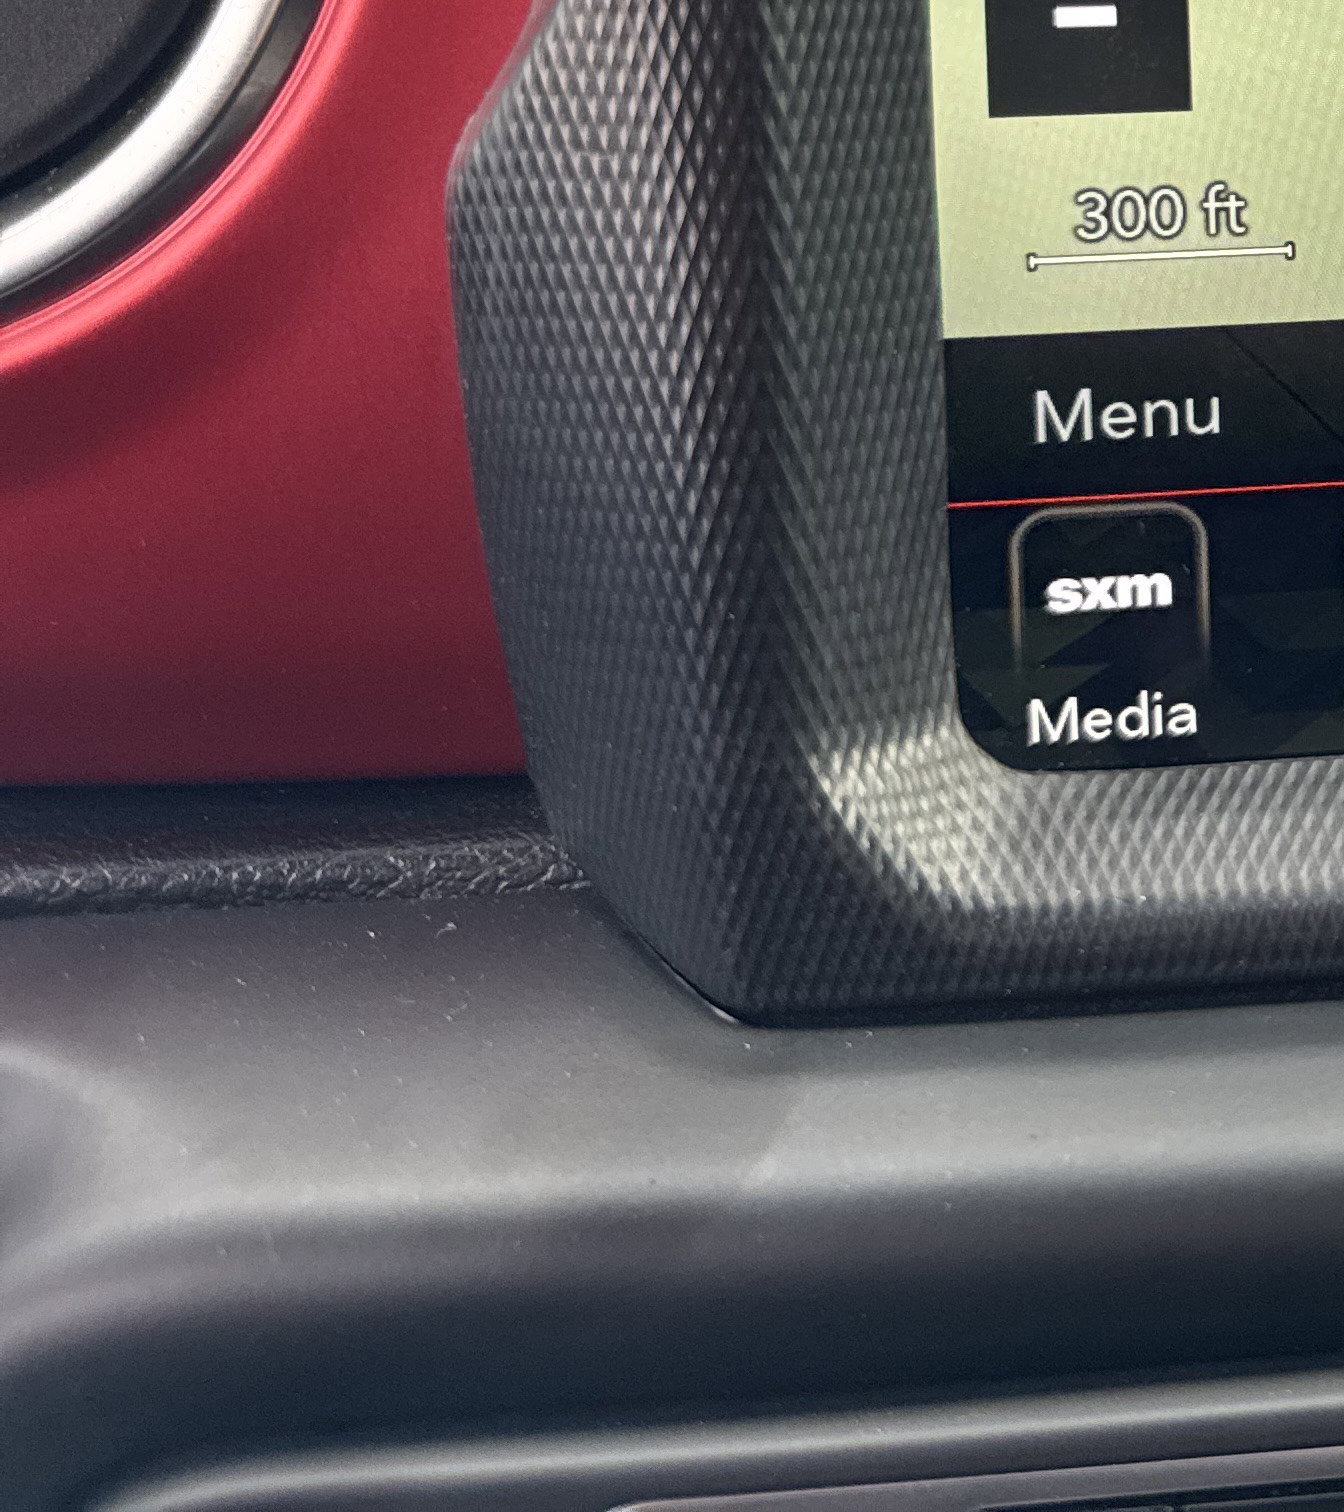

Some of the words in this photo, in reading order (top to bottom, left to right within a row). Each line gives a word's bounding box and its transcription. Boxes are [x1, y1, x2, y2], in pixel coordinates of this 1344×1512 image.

[1072, 185, 1185, 242] 300
[1200, 181, 1248, 238] ft
[1032, 386, 1222, 445] Menu
[1044, 568, 1174, 614] sxm
[1024, 690, 1199, 747] Media
